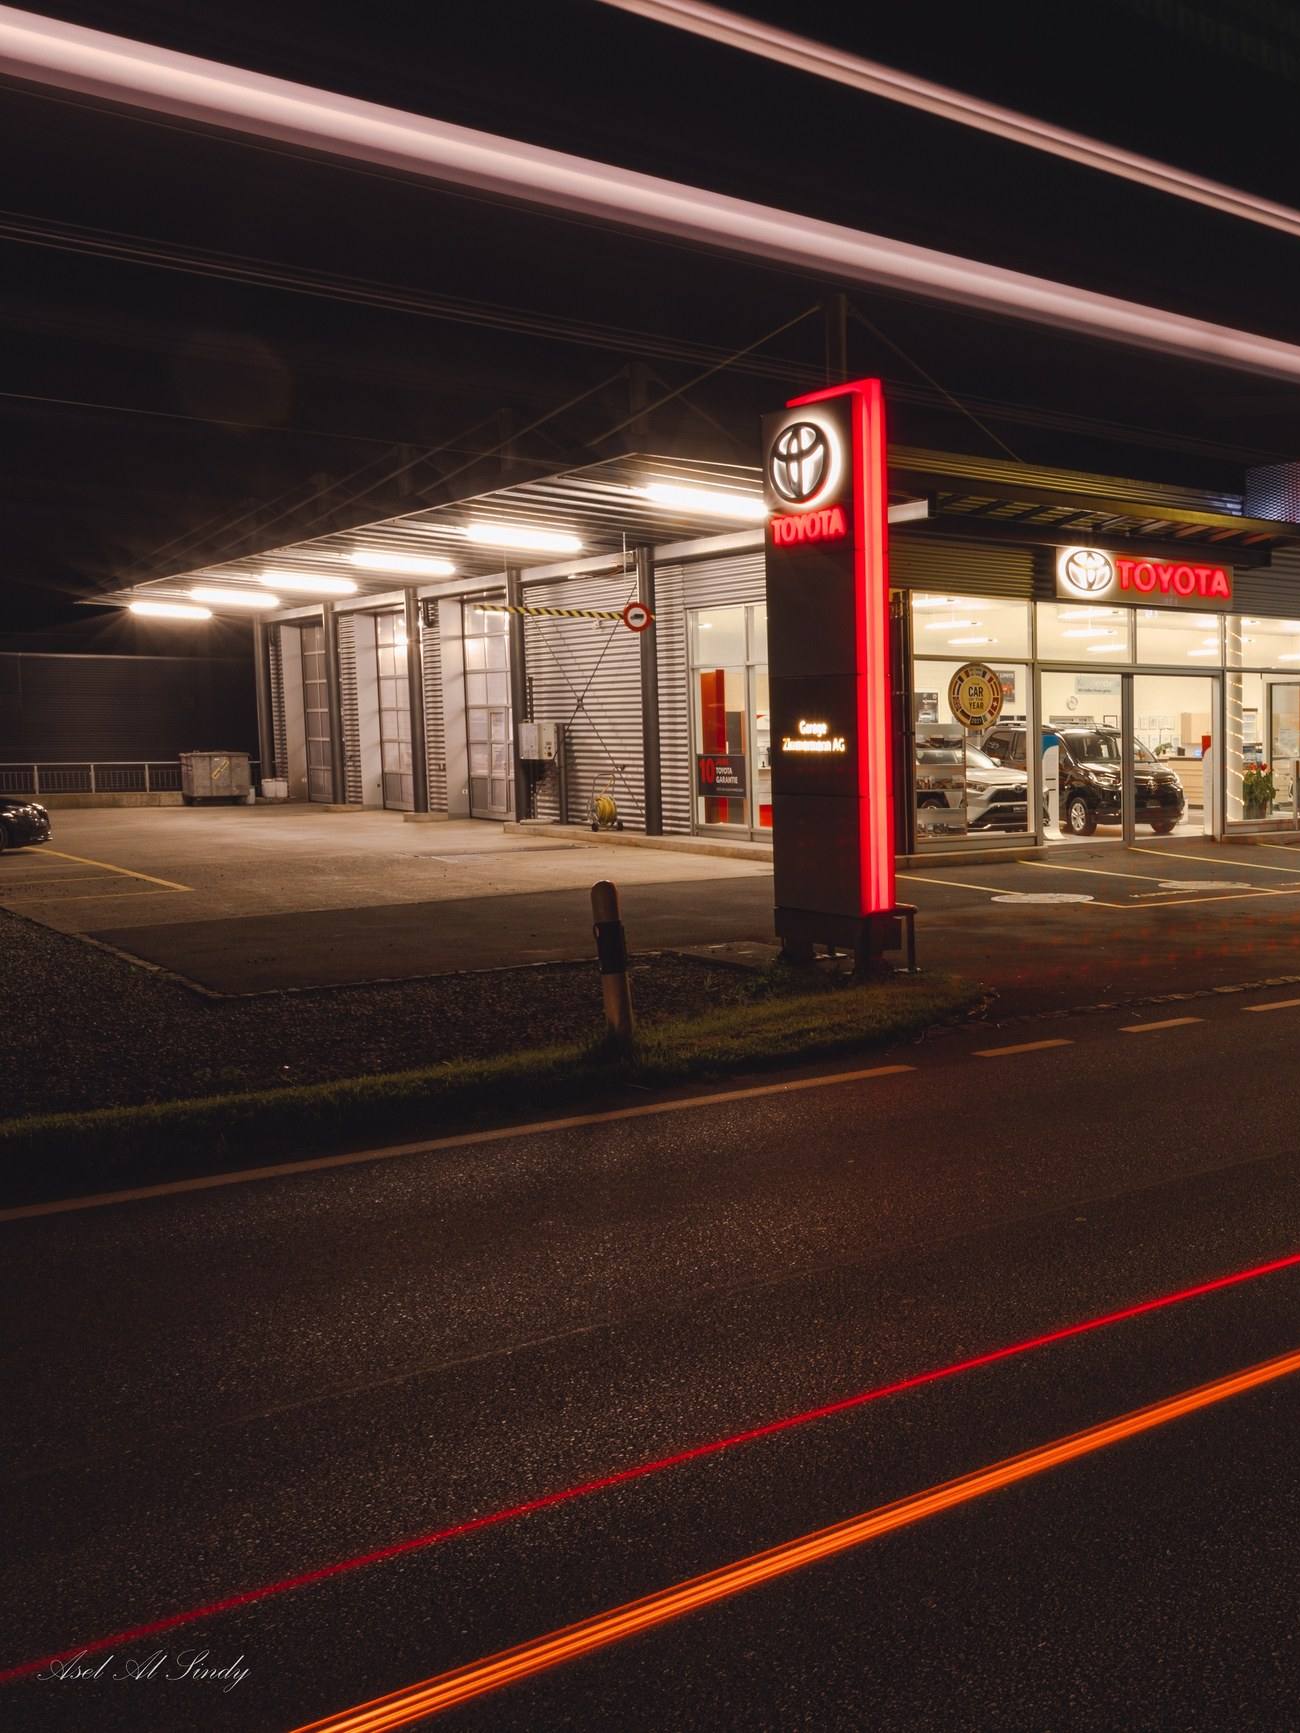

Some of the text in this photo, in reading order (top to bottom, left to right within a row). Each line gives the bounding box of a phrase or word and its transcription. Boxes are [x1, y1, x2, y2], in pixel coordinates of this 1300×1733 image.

[771, 508, 846, 544] TOYOTA
[1115, 560, 1230, 598] TOYOTA
[968, 686, 984, 698] CAR
[968, 701, 984, 710] YEAR
[832, 737, 846, 752] AG
[699, 757, 715, 785] 10
[715, 766, 733, 775] TOYOTA
